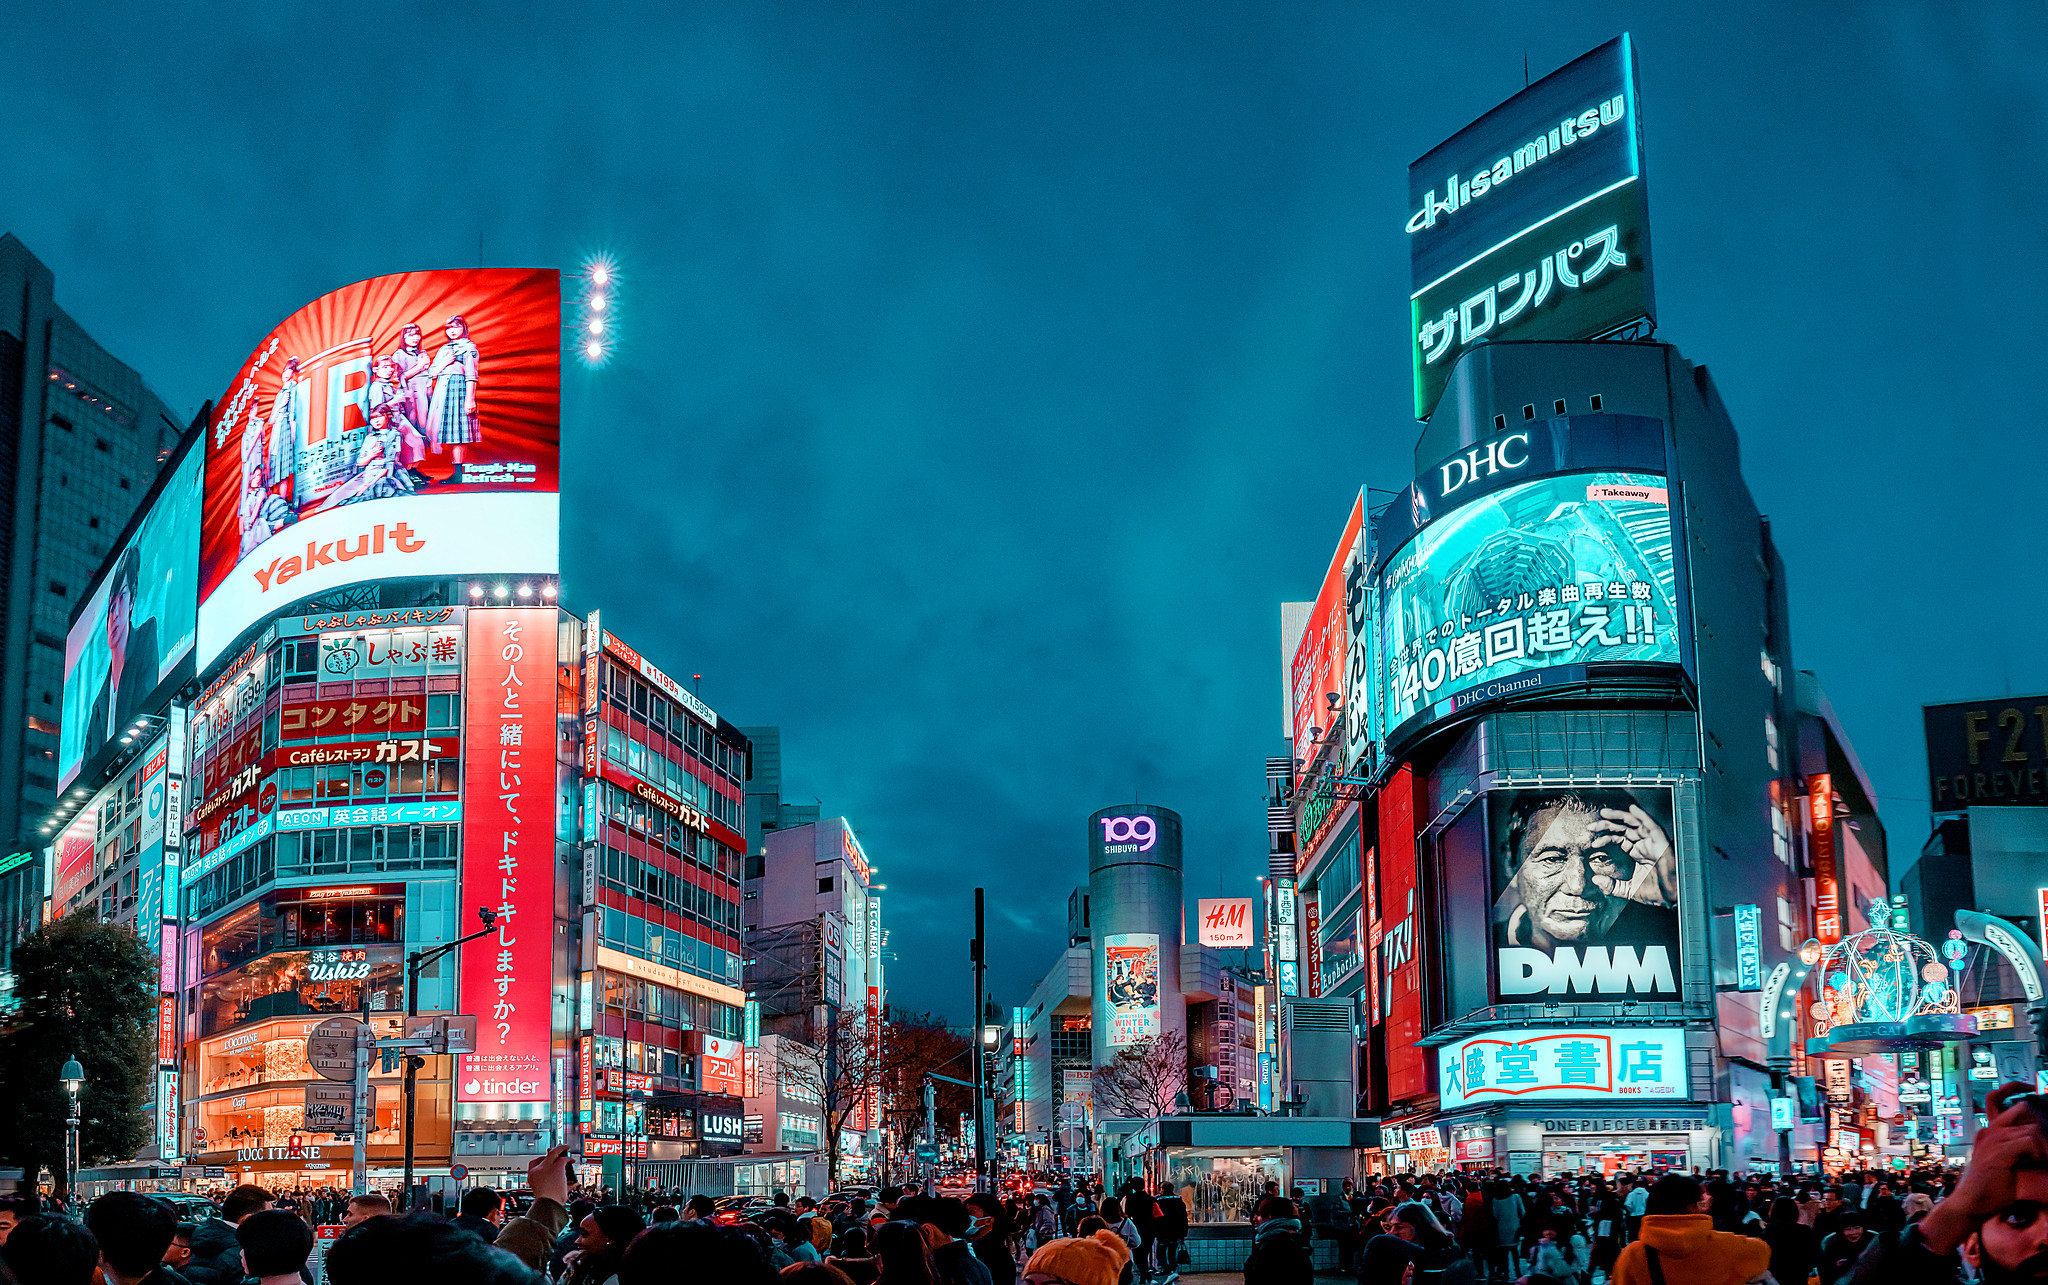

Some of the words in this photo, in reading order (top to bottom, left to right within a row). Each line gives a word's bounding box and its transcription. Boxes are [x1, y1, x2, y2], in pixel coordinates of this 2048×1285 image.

[1405, 94, 1624, 234] Hisamitsu
[1418, 224, 1627, 365] サロンパス
[1439, 433, 1529, 497] DHC
[1601, 488, 1650, 499] Takeaway
[254, 522, 426, 593] Yakult
[303, 608, 454, 631] しゃぶしゃぶバイキング
[1390, 581, 1651, 676] 全世界でのトータル楽曲再生数
[167, 634, 186, 660] NETFLIX
[368, 636, 458, 665] しゃぶ葉
[1391, 605, 1656, 714] 140億回超え!!
[1457, 689, 1485, 708] DHC
[1487, 673, 1542, 697] Channel
[283, 700, 421, 730] コンタクト
[375, 739, 442, 763] ガスト
[231, 763, 262, 800] ガスト
[1936, 768, 2048, 801] FOREVE
[169, 795, 179, 838] 献血ルーム
[219, 803, 255, 846] ガスト
[282, 811, 323, 827] AEON
[333, 805, 458, 824] 英会話イーオン
[678, 804, 710, 832] ガスト
[1101, 815, 1157, 852] 109
[184, 864, 200, 881] AEON
[204, 830, 254, 871] 英会話イーオン
[258, 821, 267, 836] 6F
[1105, 844, 1138, 854] SHIBUYA
[1205, 904, 1246, 929] H&M
[1281, 901, 1292, 916] 西村
[826, 920, 840, 951] OS
[869, 919, 878, 959] CAMERA
[307, 961, 372, 981] Ushi8
[638, 964, 666, 978] studio
[1310, 930, 1320, 996] ウィンターフルー
[1323, 951, 1357, 989] Euphoria
[1499, 945, 1676, 995] DMM
[1114, 1019, 1150, 1027] WINTER
[1120, 1026, 1144, 1034] SALE
[224, 1033, 258, 1050] L'OCCITANE
[465, 1054, 540, 1063] 普通は出会えない人と、
[465, 1063, 540, 1072] 普通に出会えるアプリ。
[710, 1059, 736, 1078] アコム
[1445, 1041, 1663, 1096] 大盛堂書店
[482, 1078, 540, 1094] tinder
[1618, 1086, 1642, 1094] BOOKS
[703, 1114, 742, 1136] LUSH
[1015, 1103, 1023, 1132] HOOTERS
[1545, 1119, 1576, 1131] ONE
[1581, 1119, 1635, 1131] PIECE
